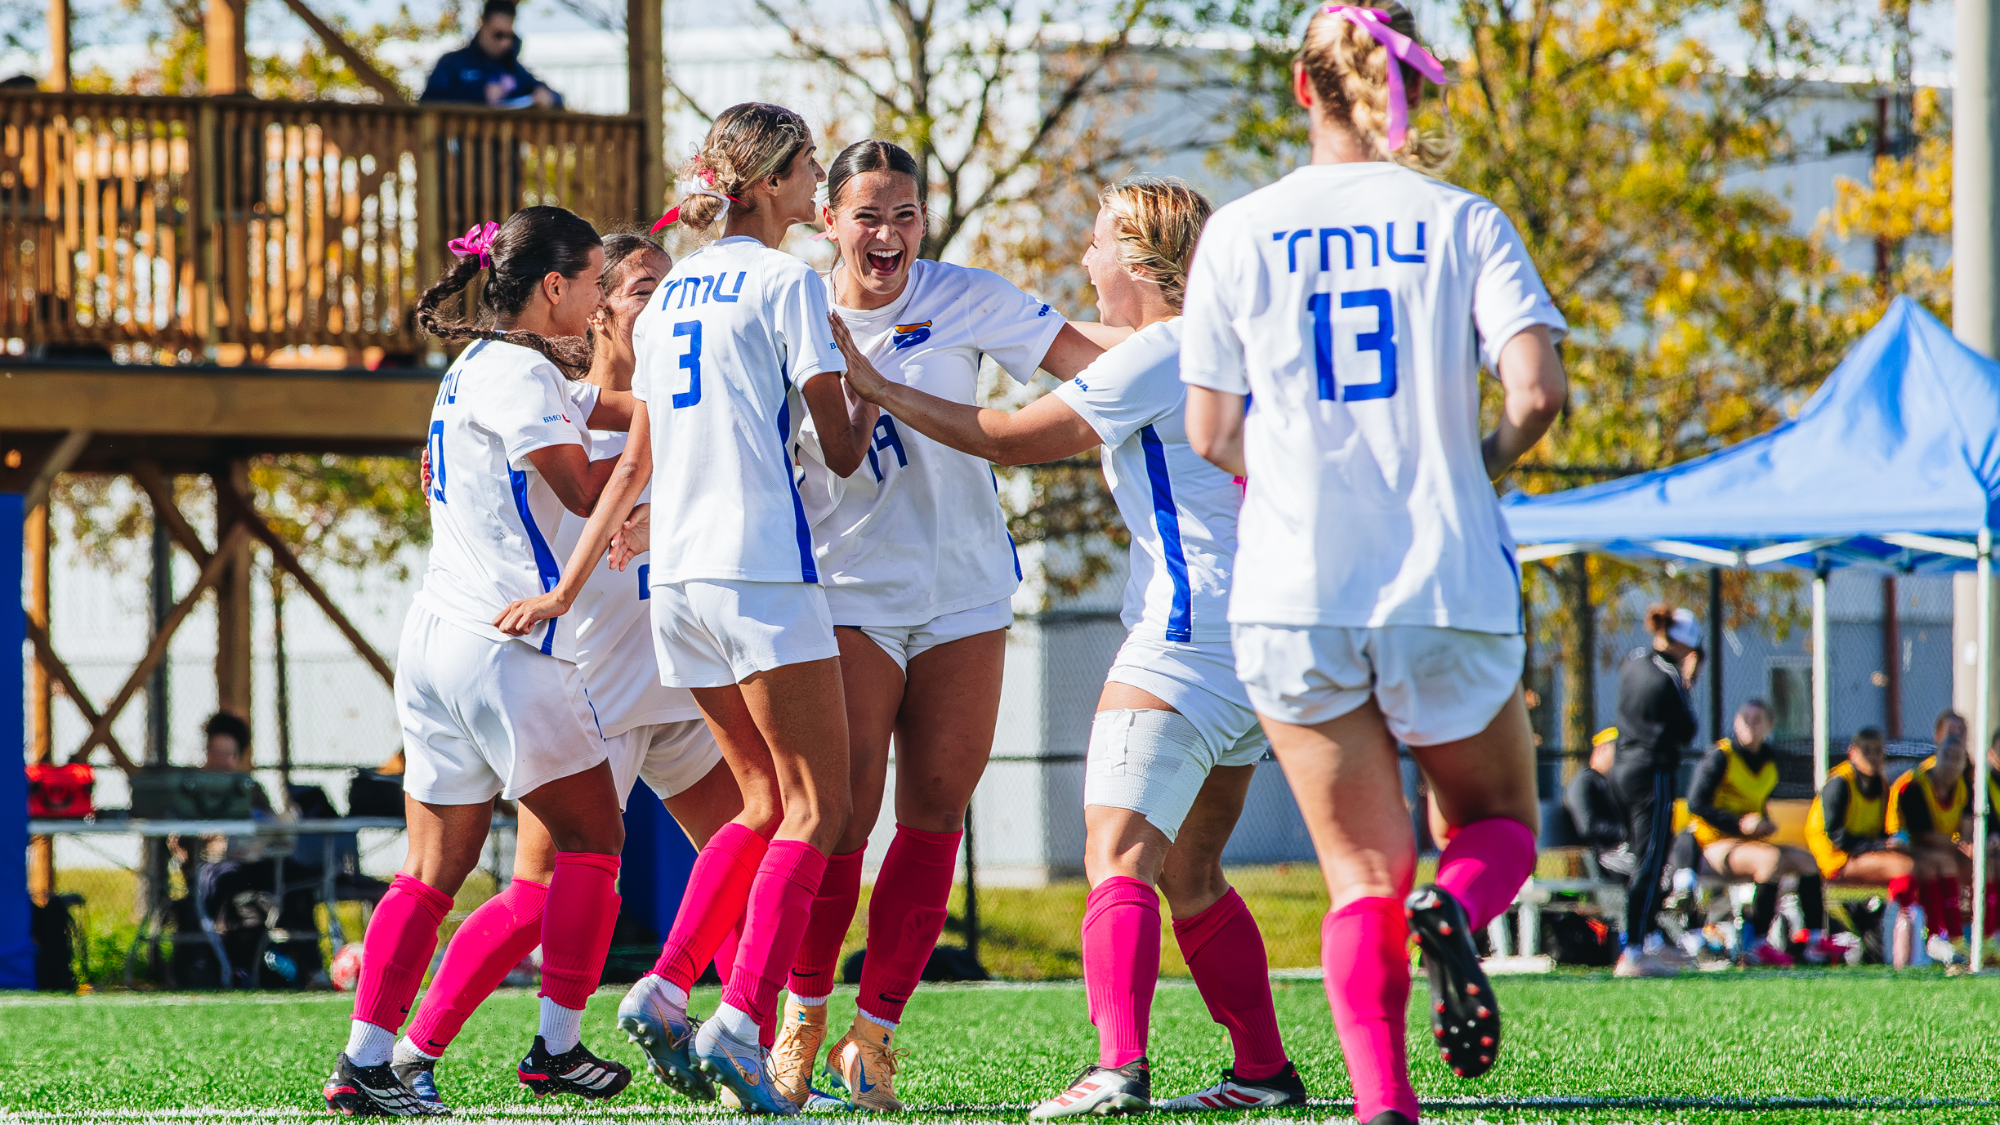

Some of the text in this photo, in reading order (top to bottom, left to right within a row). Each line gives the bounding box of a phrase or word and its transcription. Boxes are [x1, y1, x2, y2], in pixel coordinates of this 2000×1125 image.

[1273, 221, 1426, 273] TMU
[662, 271, 747, 311] TMU
[672, 319, 703, 410] 3
[1307, 288, 1398, 402] 13
[437, 369, 463, 406] MU
[1074, 376, 1090, 393] UA
[542, 413, 562, 424] BMO
[867, 414, 909, 484] 19
